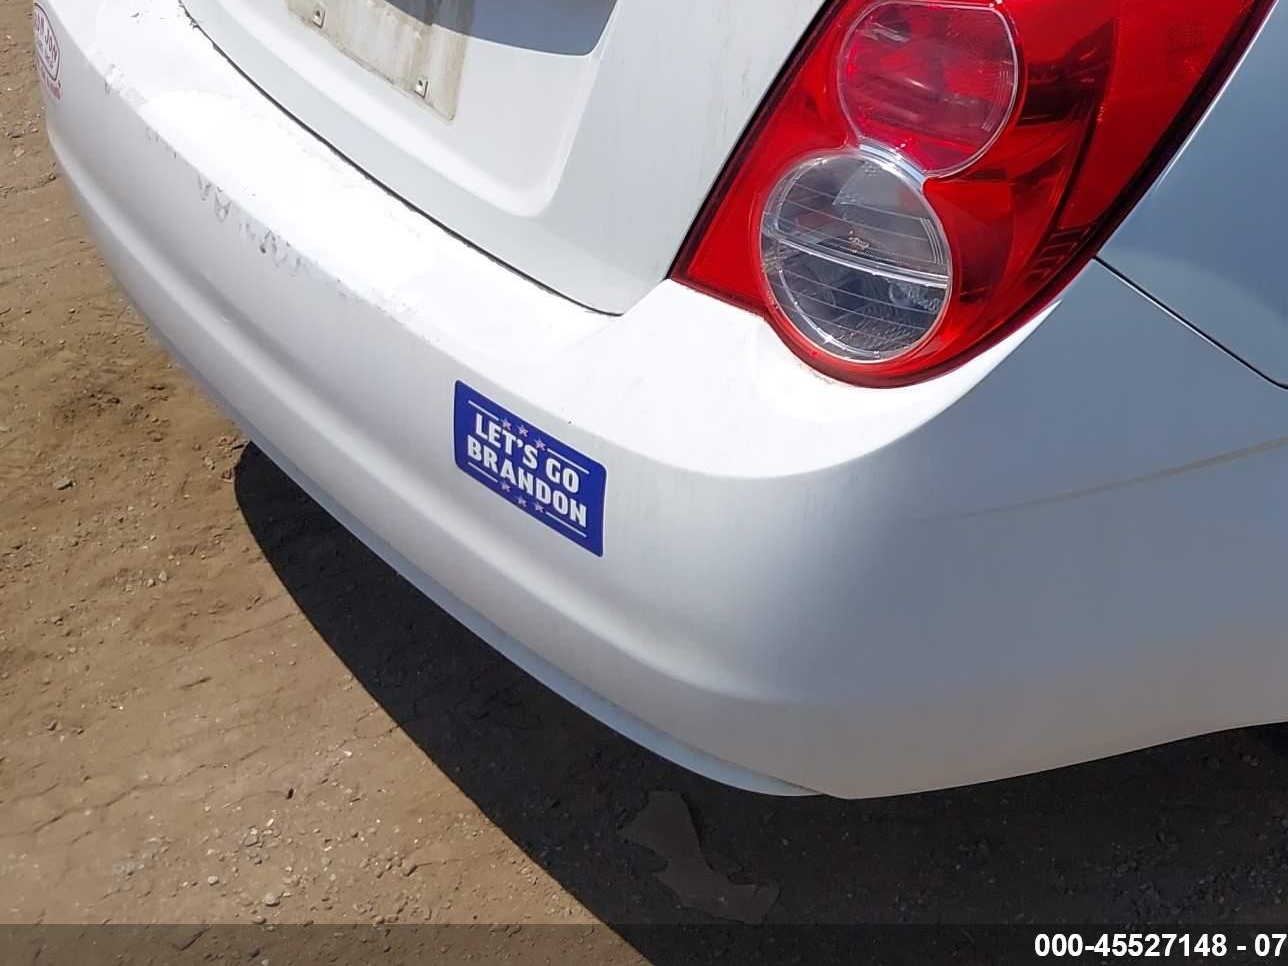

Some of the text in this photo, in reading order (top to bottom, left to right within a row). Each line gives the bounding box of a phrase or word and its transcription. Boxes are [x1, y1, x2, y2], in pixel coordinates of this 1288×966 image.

[467, 434, 587, 528] BRANDON
[475, 412, 580, 494] LET'S GO
